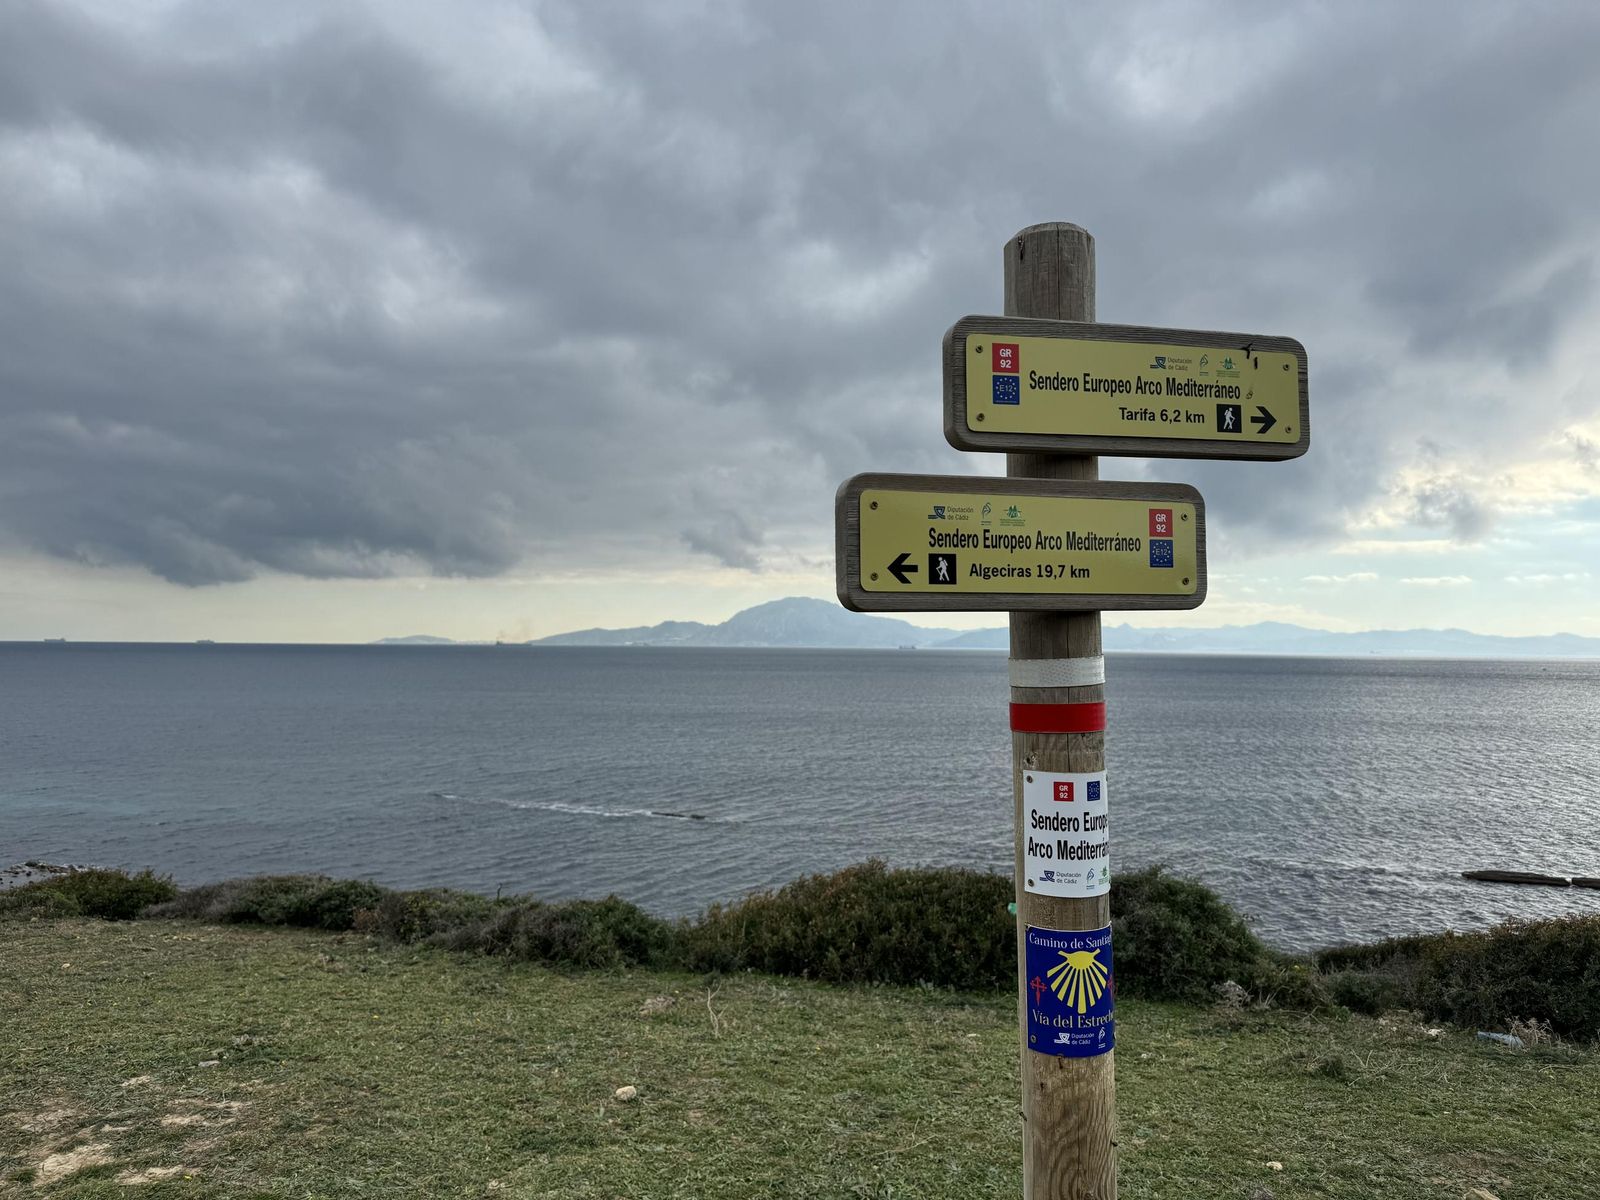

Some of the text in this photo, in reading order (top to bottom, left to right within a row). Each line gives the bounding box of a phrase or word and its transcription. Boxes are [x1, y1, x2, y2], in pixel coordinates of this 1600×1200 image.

[999, 348, 1012, 358] GR
[999, 359, 1012, 369] 92
[999, 384, 1013, 392] E12
[1029, 369, 1241, 400] Sendero Europeo Arco Mediterráneo
[1118, 407, 1205, 425] Tarifa 6,2 km
[947, 505, 974, 515] Diputación
[1155, 513, 1167, 523] GR
[1156, 523, 1167, 533] 92
[928, 527, 1141, 554] Sendero Europeo Arco Mediterráneo
[1155, 548, 1168, 556] E12
[969, 563, 1090, 580] Algeciras 19,7 km
[1058, 784, 1069, 792] GR
[1031, 808, 1080, 832] Sendero
[1027, 836, 1053, 859] Arco
[1029, 932, 1068, 949] Camino
[1070, 938, 1084, 949] de
[1032, 1008, 1050, 1026] Vía
[1053, 1014, 1073, 1028] del
[1071, 1032, 1095, 1040] Diputación
